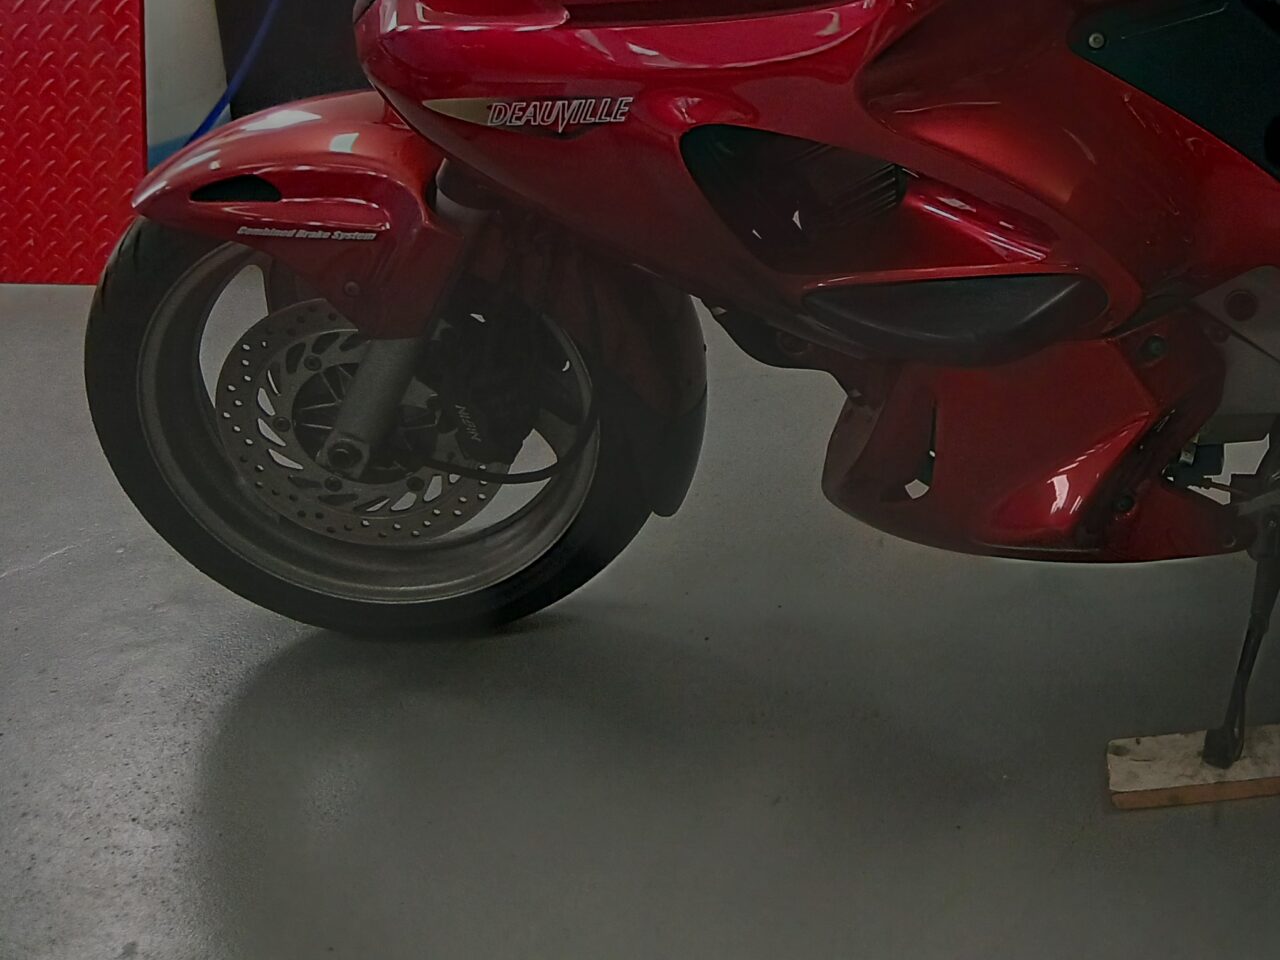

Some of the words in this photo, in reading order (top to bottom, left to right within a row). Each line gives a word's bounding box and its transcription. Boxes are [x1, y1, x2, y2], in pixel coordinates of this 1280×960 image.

[487, 96, 634, 134] DEAUVILLE
[236, 226, 297, 238] Combined
[295, 229, 332, 239] Brake
[331, 230, 377, 240] System
